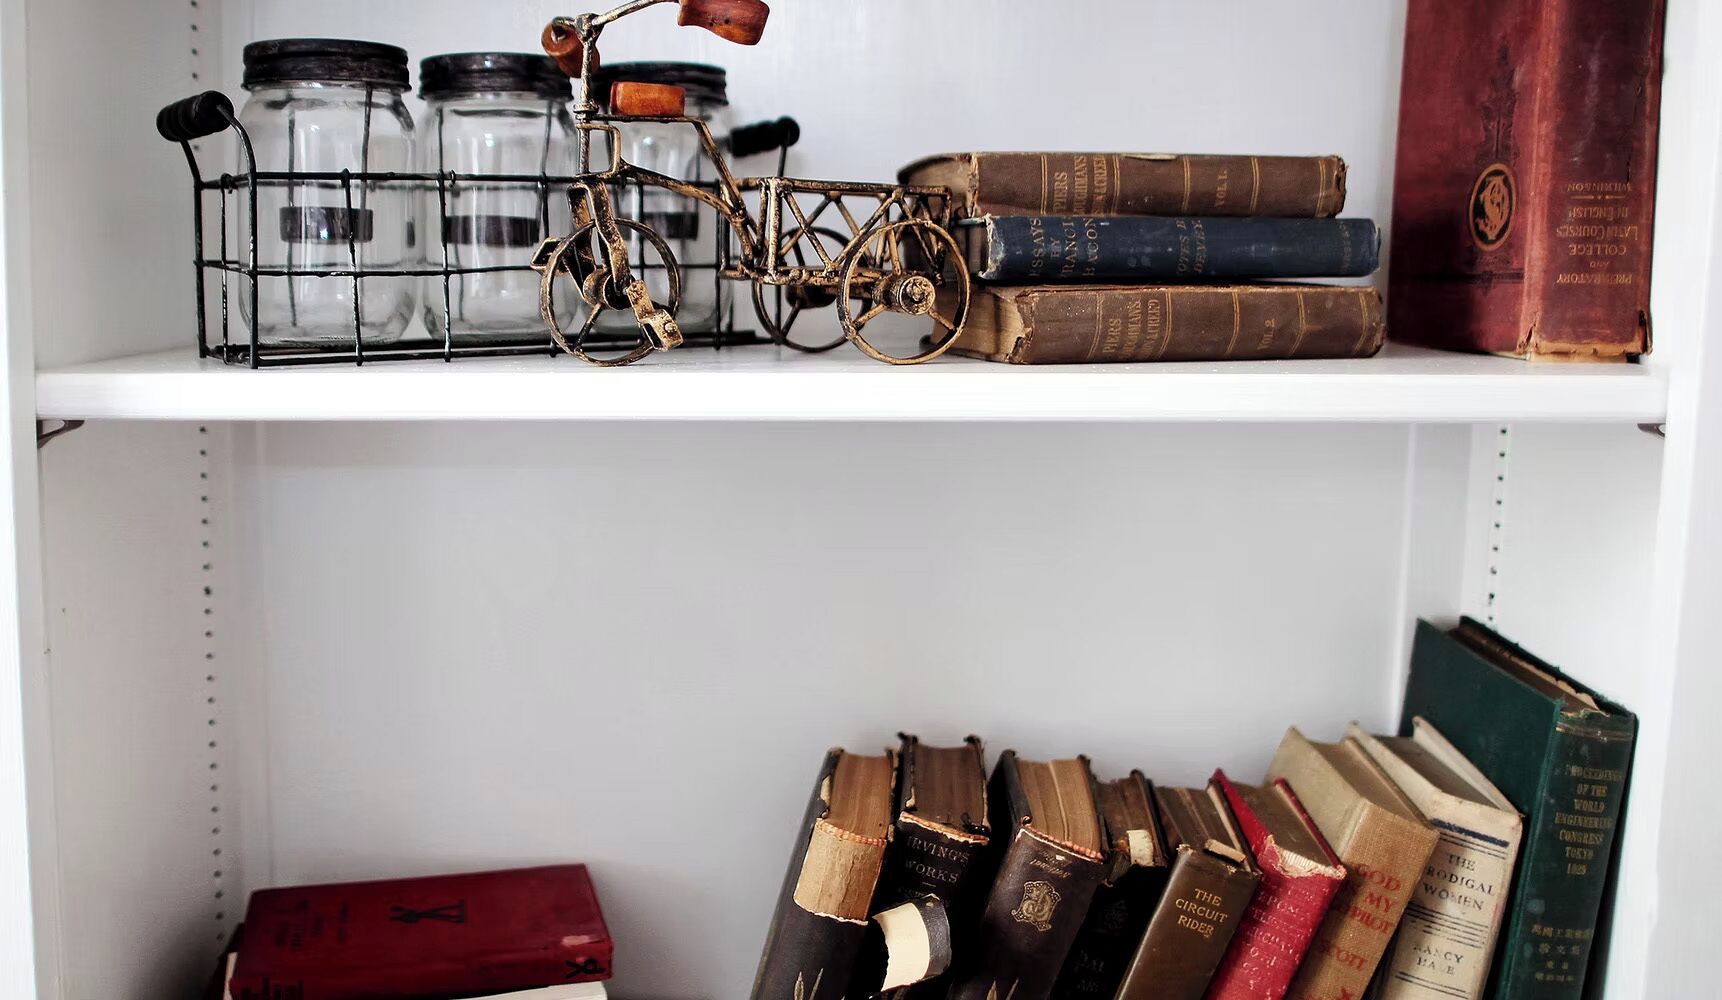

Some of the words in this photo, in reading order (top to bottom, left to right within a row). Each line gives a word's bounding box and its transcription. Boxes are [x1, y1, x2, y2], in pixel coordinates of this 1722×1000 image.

[1053, 170, 1068, 213] PIERS
[1567, 182, 1633, 192] WILKINSON
[1568, 206, 1614, 220] ENGLISH
[1556, 225, 1605, 240] COURSES
[1028, 217, 1045, 277] SSAYS
[1062, 217, 1078, 277] RANCI
[1176, 235, 1190, 273] OTES
[1568, 243, 1628, 256] COLLEGE
[1556, 273, 1633, 284] PREARATORY
[1265, 318, 1275, 328] 2
[1102, 317, 1121, 353] PIERS
[1577, 783, 1589, 795] OF
[1590, 785, 1608, 797] THE
[1574, 799, 1605, 813] WORLD
[1559, 830, 1604, 845] CONGRESS
[1448, 853, 1477, 871] THE
[1565, 846, 1594, 860] TOKYO
[906, 860, 959, 883] WORKS
[1355, 863, 1401, 891] GOD
[1426, 865, 1496, 897] RODIGAL
[1194, 888, 1222, 907] THE
[1365, 890, 1398, 913] MY
[1423, 882, 1485, 911] WOMEN
[1175, 898, 1228, 923] CIRCUIT
[1177, 914, 1214, 935] RIDER
[1416, 956, 1455, 975] HAE
